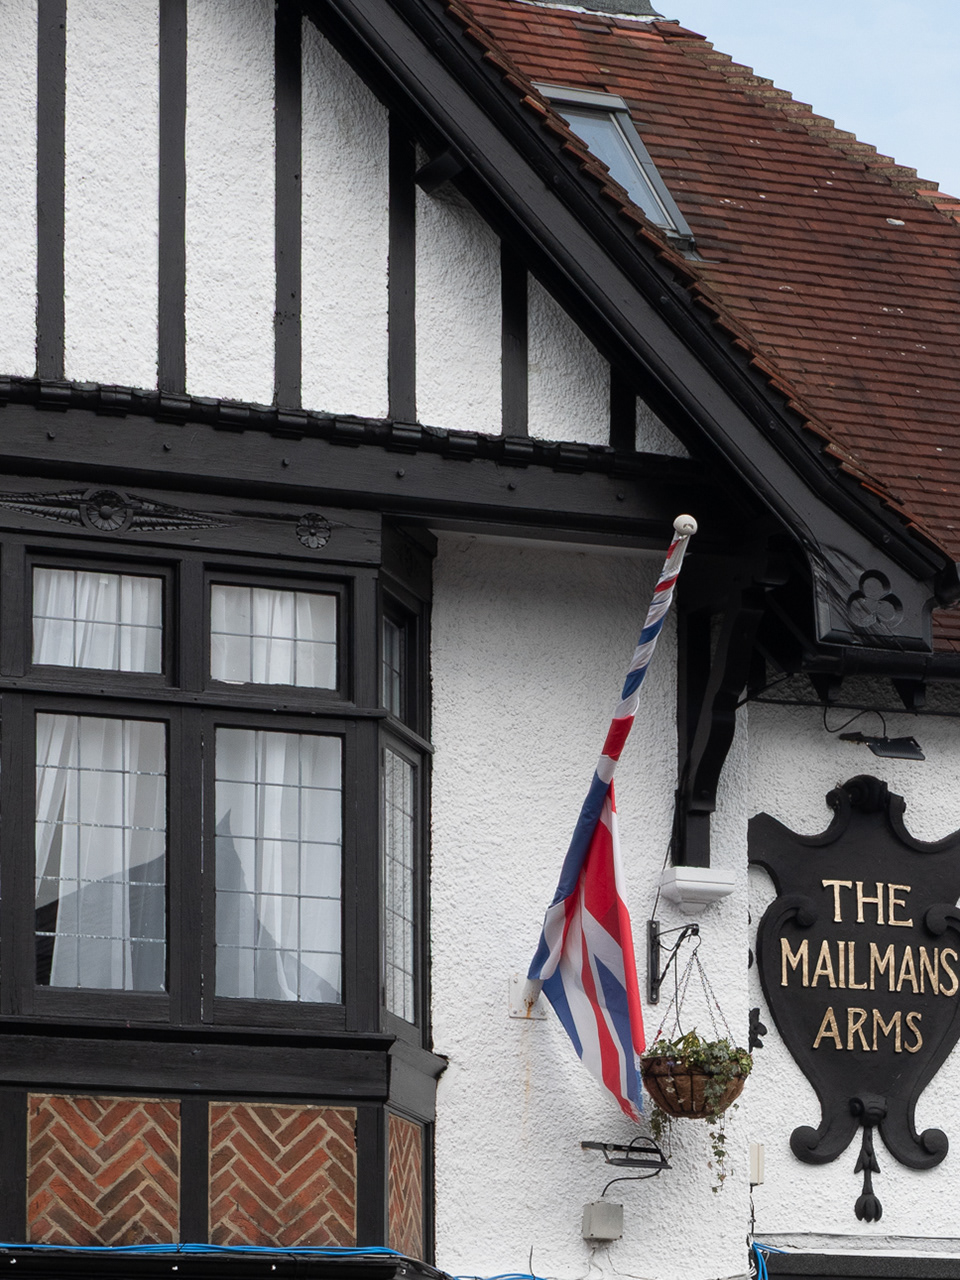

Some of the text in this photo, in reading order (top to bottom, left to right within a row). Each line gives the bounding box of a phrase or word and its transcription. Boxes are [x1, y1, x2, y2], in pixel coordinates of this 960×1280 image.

[822, 880, 913, 927] THE
[781, 938, 958, 996] MAILMANS
[813, 1007, 922, 1052] ARMS
